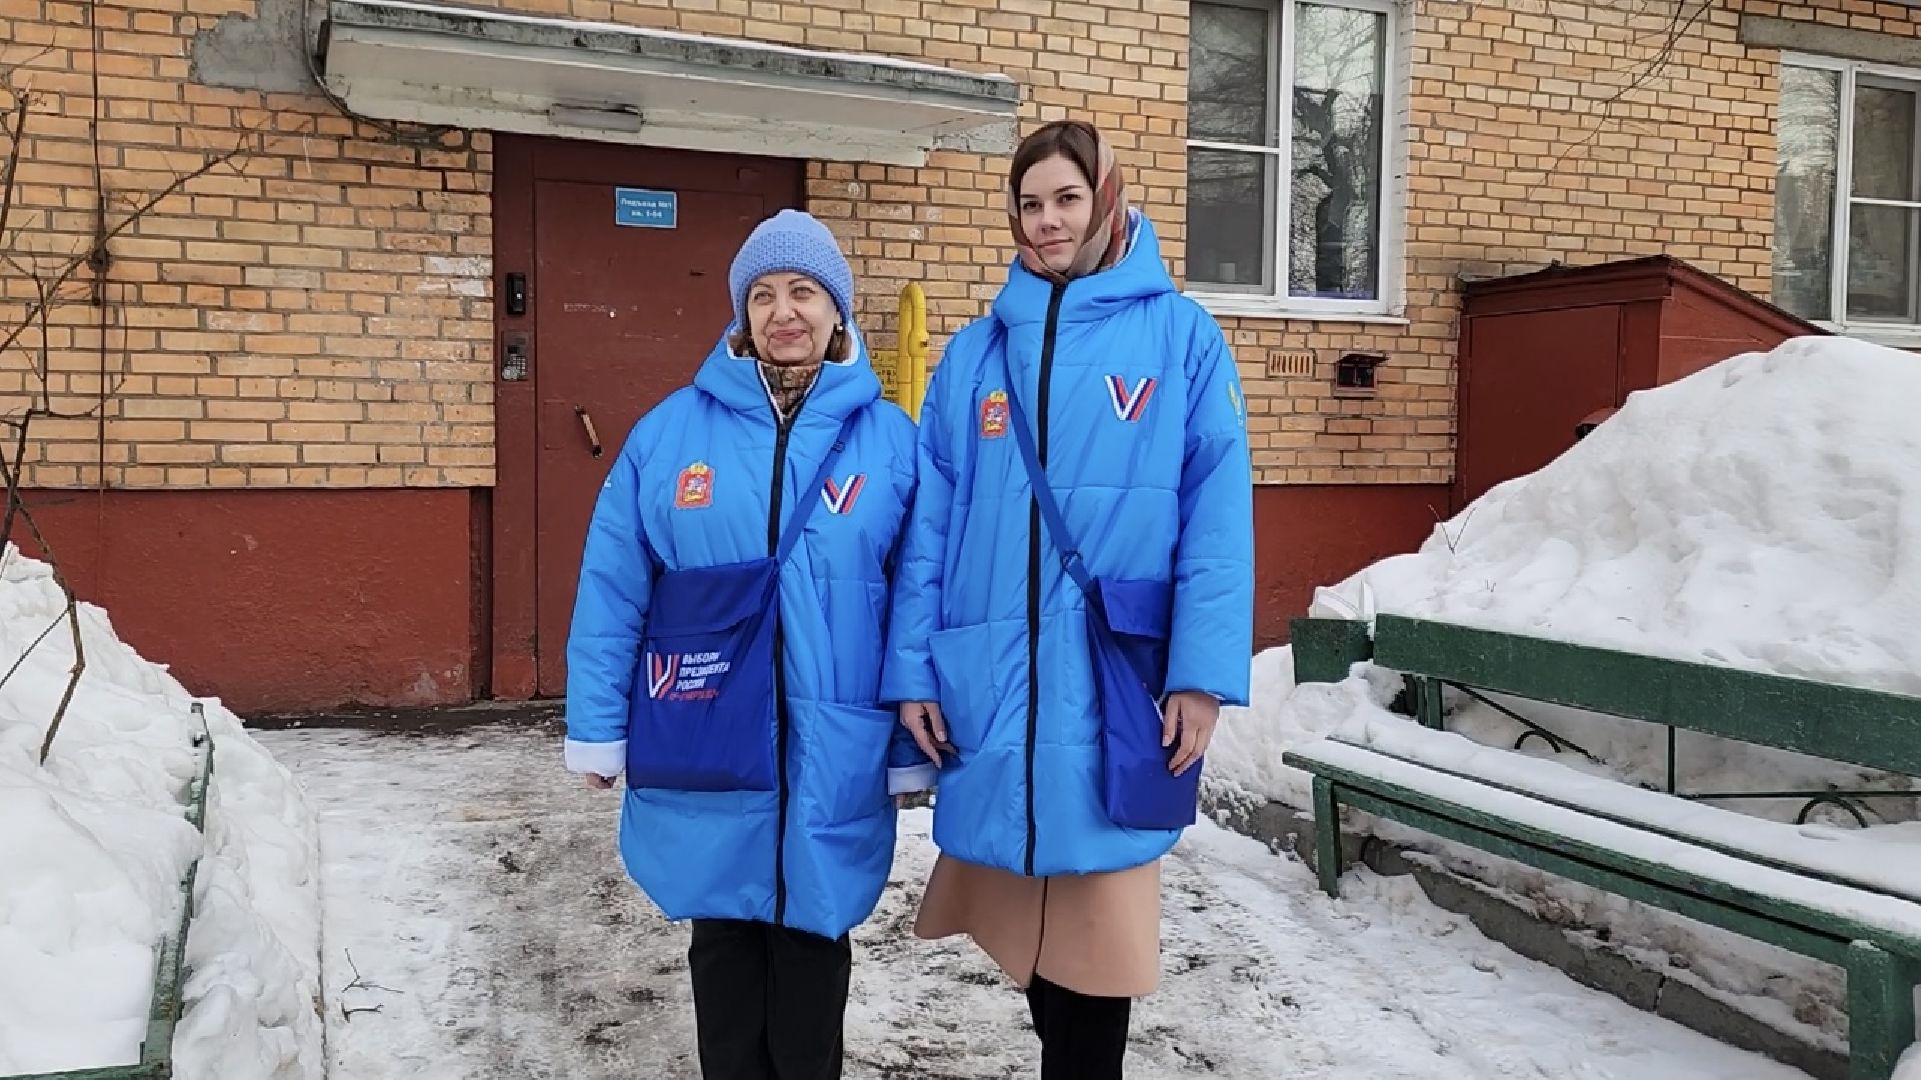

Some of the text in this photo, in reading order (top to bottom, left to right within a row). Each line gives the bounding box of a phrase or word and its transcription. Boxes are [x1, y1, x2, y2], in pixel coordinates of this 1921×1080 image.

[682, 652, 721, 665] ВЫБОРЫ
[679, 662, 730, 677] ПРЕЗИДЕНТА
[675, 677, 707, 691] РОССИИ
